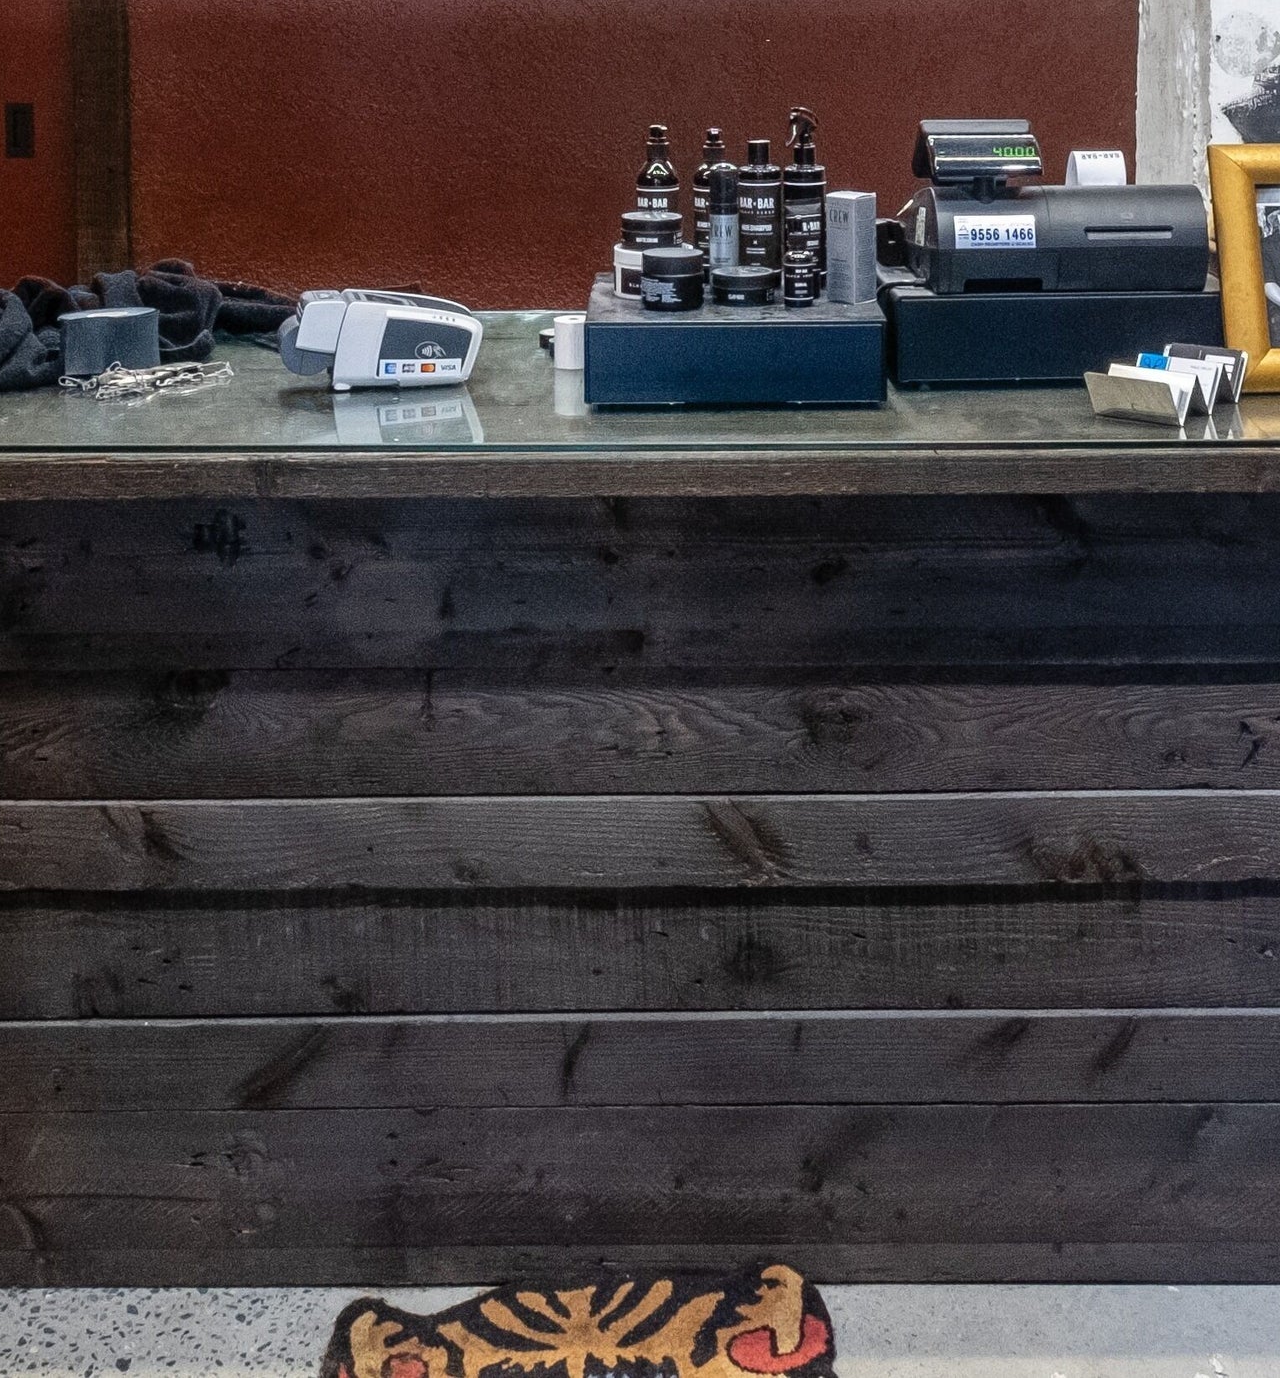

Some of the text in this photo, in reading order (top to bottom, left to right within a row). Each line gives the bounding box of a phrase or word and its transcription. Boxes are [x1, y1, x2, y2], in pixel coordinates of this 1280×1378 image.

[829, 209, 849, 222] CREW
[970, 227, 1034, 241] 9556 1466
